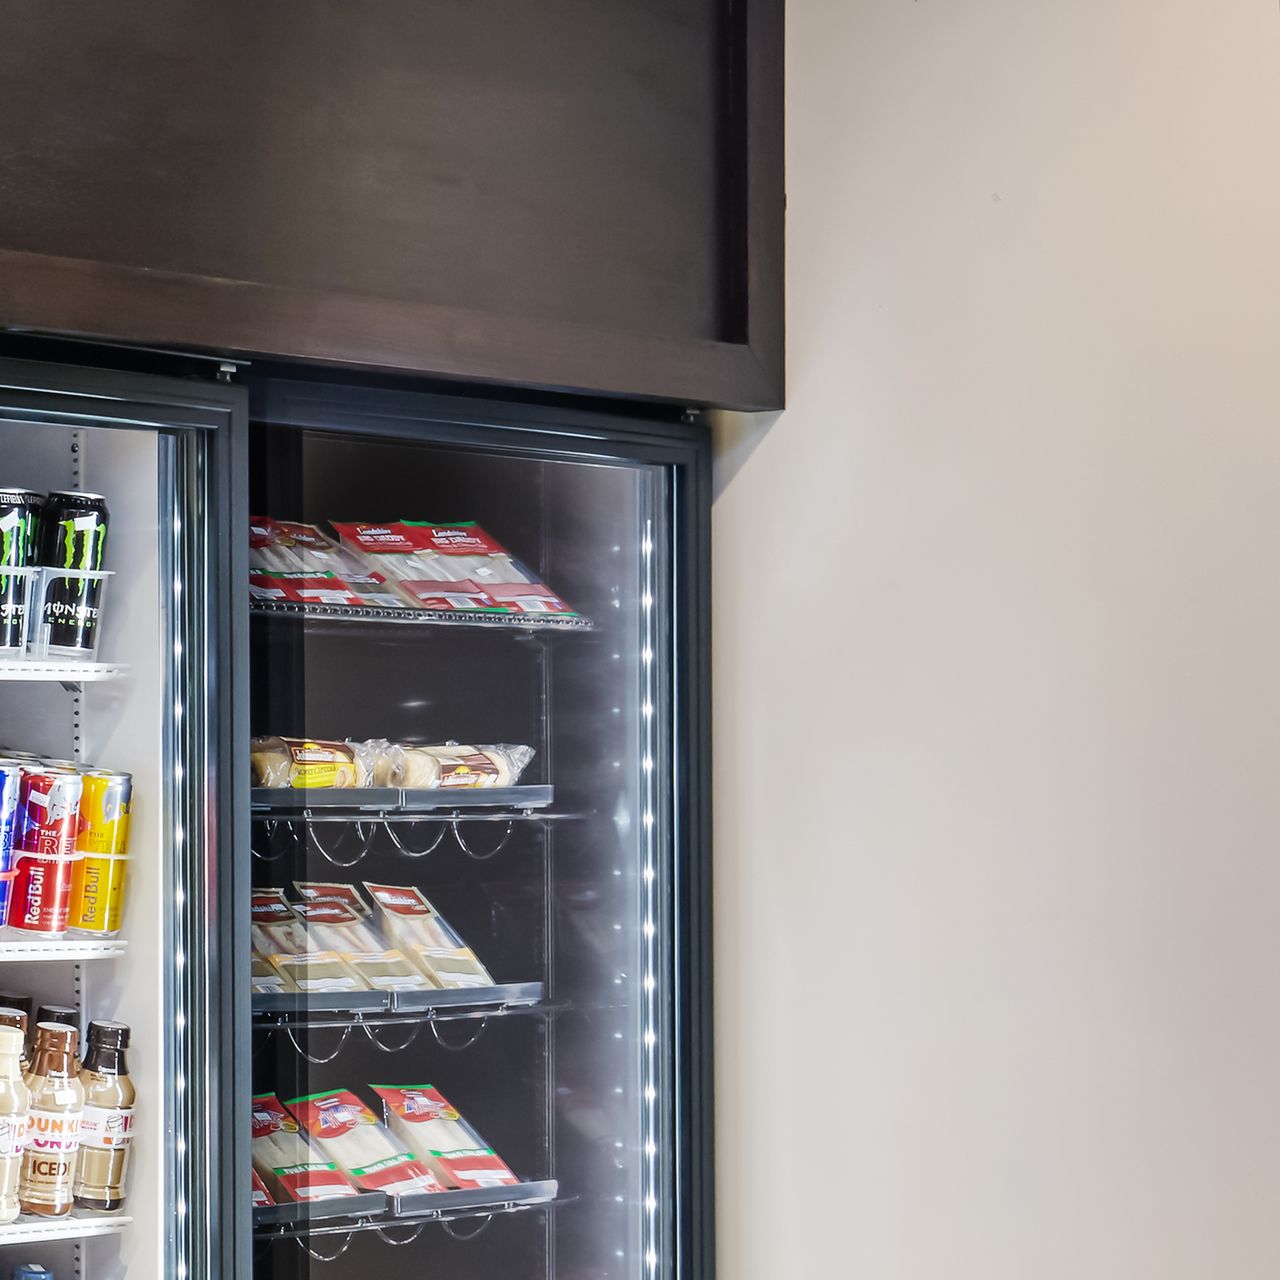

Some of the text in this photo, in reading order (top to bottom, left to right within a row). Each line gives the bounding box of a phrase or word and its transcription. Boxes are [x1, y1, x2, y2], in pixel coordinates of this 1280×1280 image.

[24, 866, 45, 925] Red Bull
[81, 866, 100, 923] Red Bull
